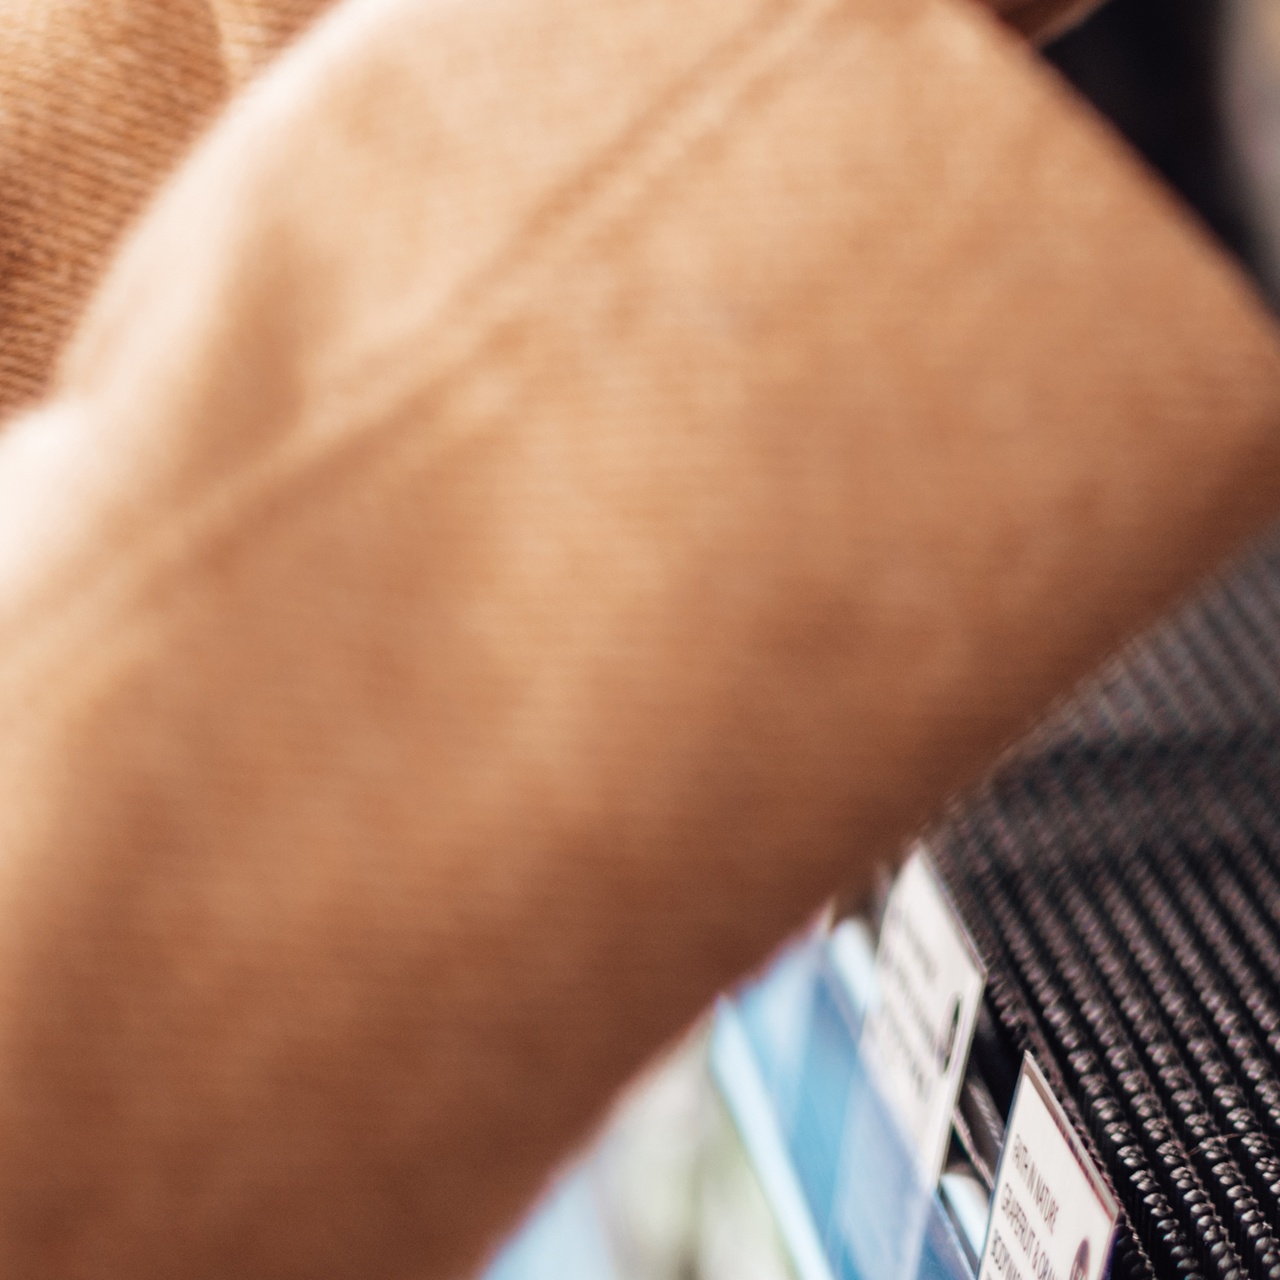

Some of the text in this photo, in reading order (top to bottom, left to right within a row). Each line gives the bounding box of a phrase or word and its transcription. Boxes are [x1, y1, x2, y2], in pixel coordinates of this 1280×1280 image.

[1001, 1182, 1036, 1260] GRAPEFRUIT
[1031, 1240, 1040, 1271] &
[1026, 1161, 1038, 1196] IN
[1033, 1173, 1059, 1235] NATURE
[990, 1228, 1011, 1278] BODY
